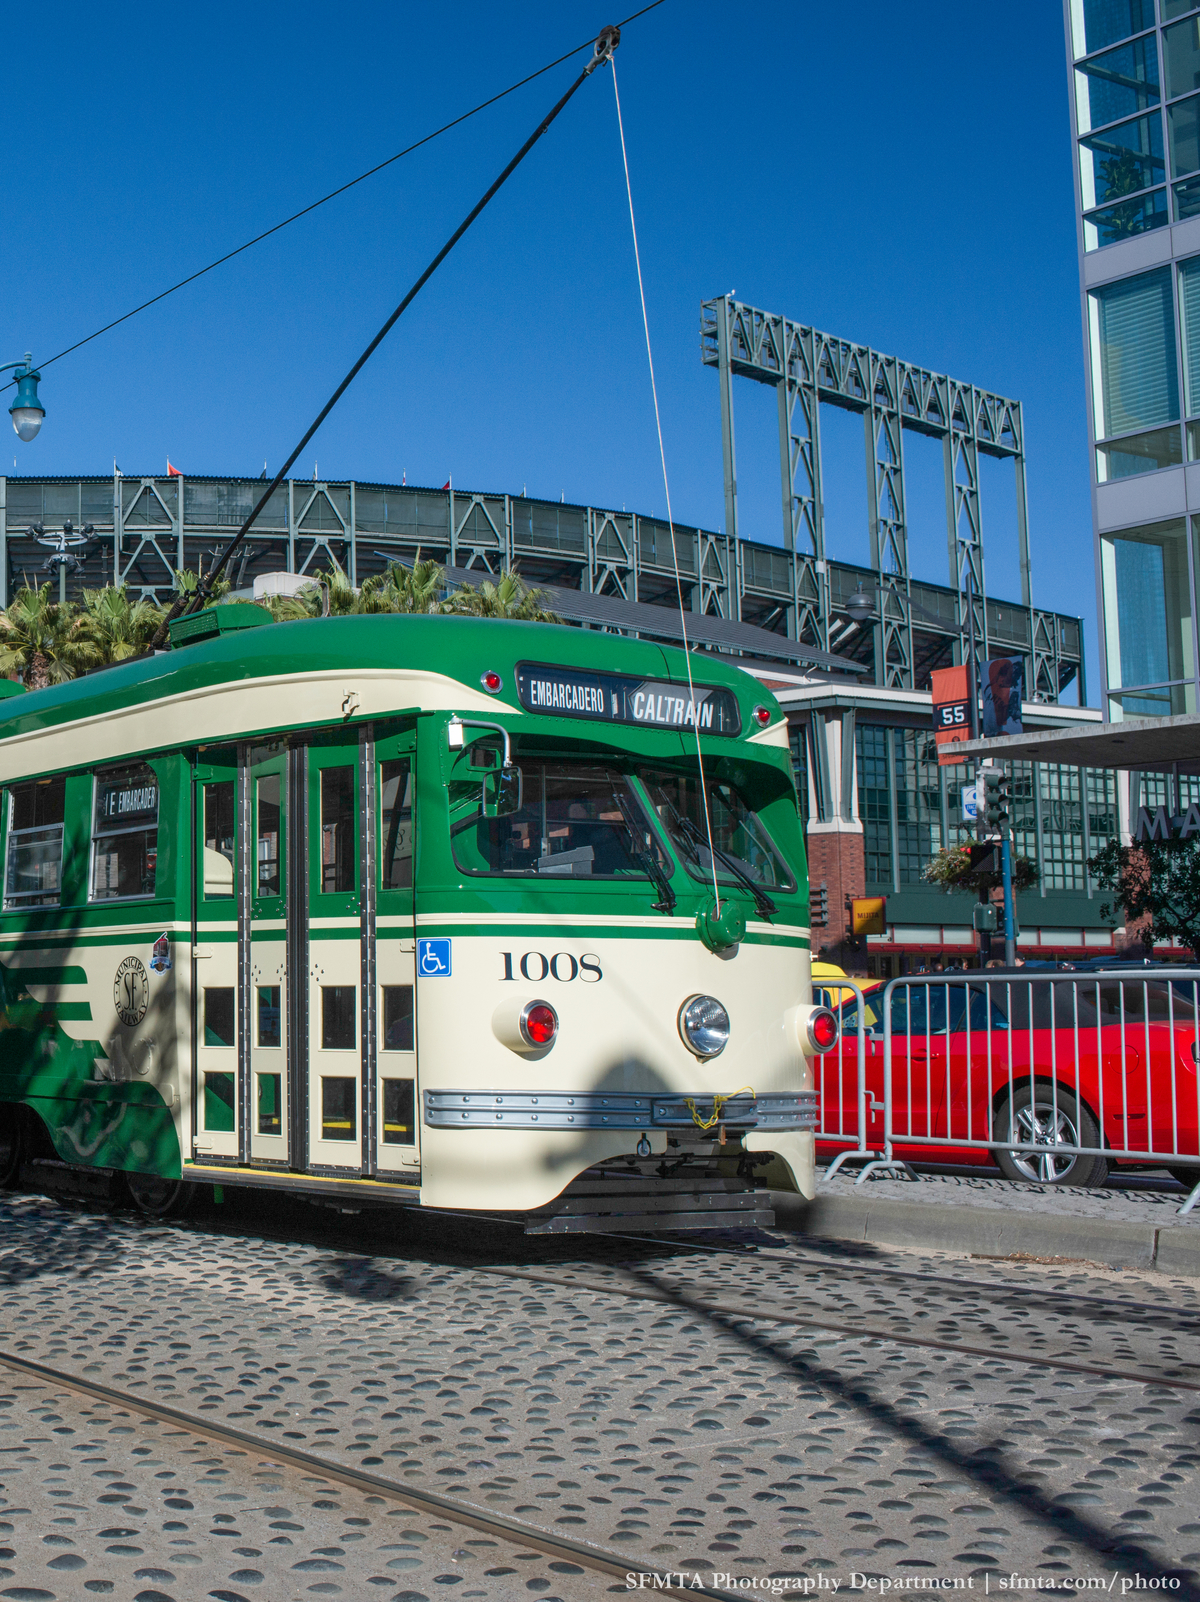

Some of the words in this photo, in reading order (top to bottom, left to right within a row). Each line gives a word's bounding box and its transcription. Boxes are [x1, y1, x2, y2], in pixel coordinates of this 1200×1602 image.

[530, 680, 604, 713] EMBARCADERO
[633, 691, 714, 728] CALTRAIN
[942, 705, 965, 725] 55
[118, 786, 156, 814] EMBARCADER
[498, 951, 603, 983] 1008
